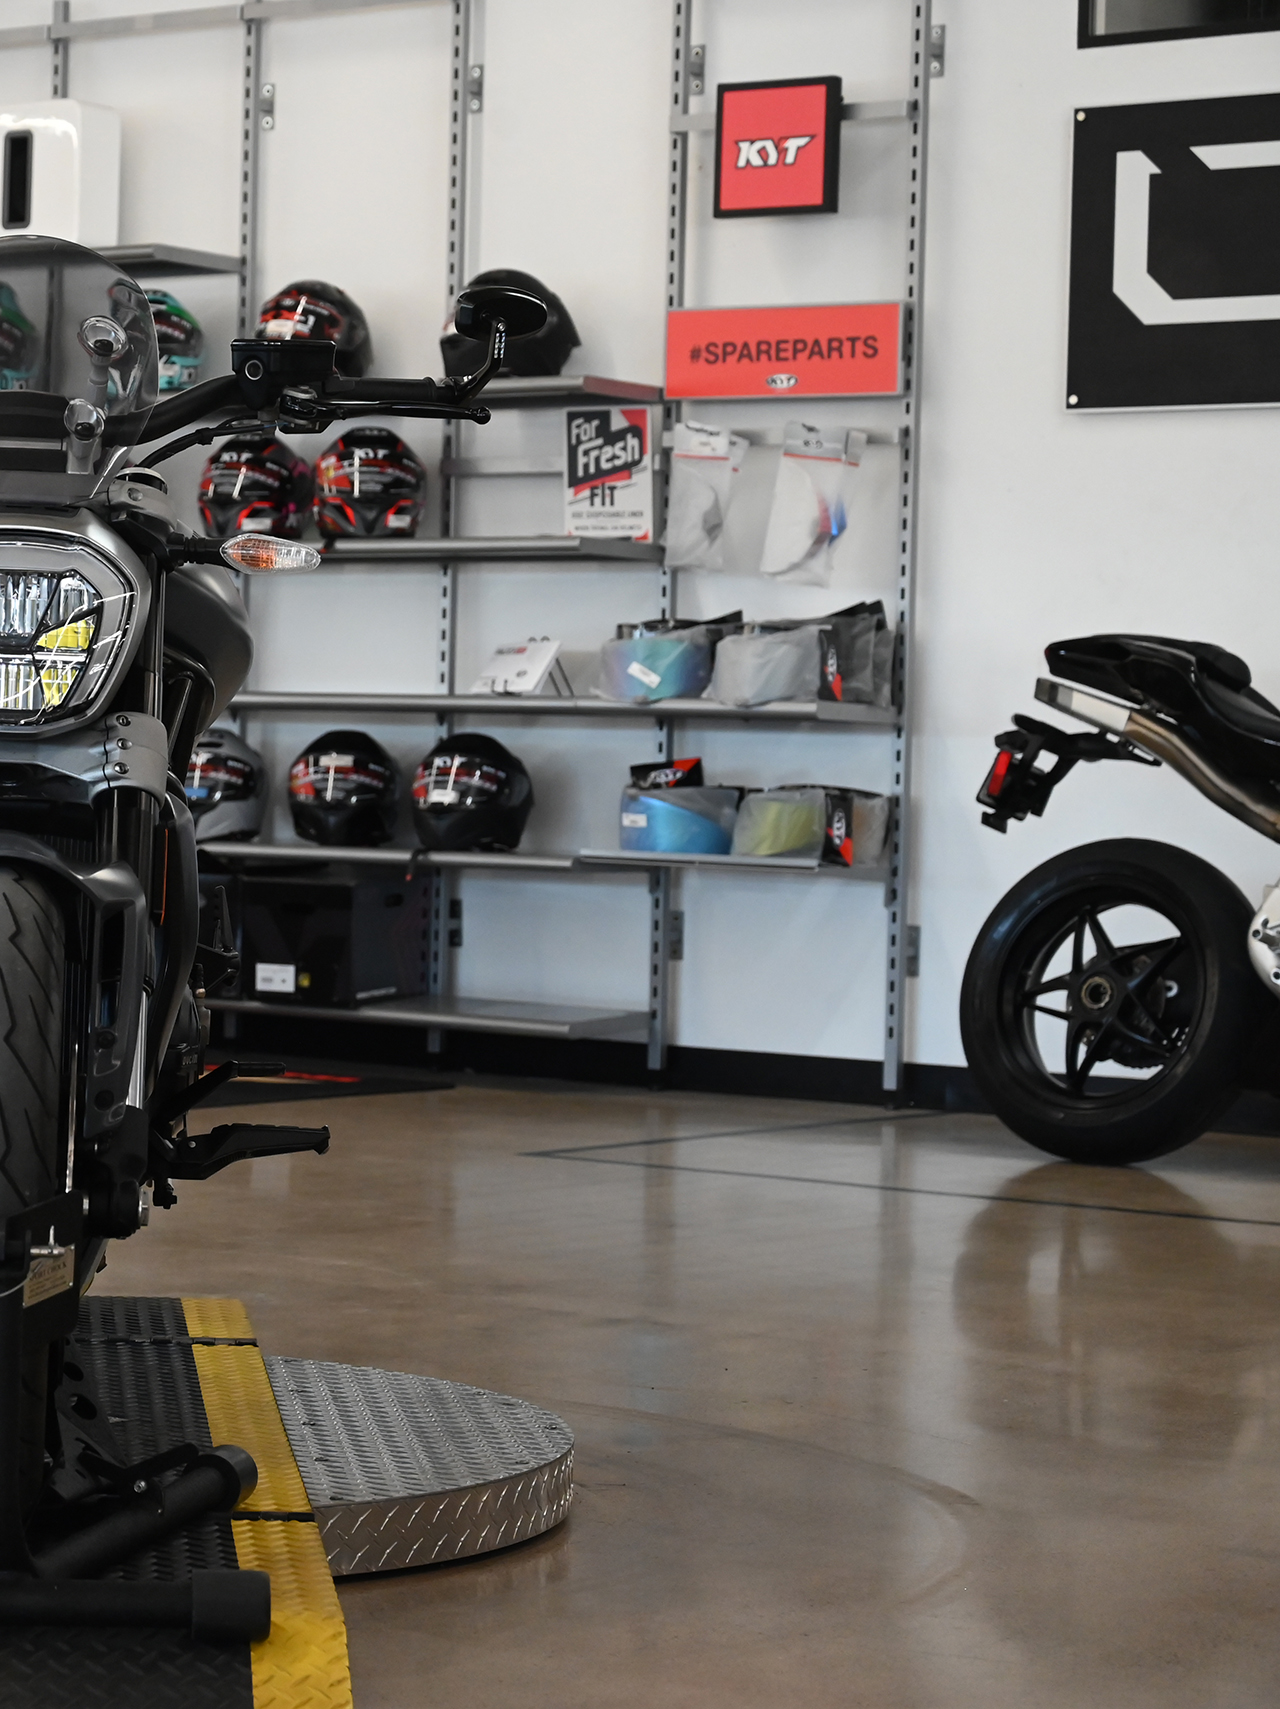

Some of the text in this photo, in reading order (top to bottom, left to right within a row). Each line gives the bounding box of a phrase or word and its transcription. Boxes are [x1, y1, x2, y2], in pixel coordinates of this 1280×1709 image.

[735, 134, 816, 169] KYT
[689, 335, 879, 365] #SPAREPARTS
[571, 417, 600, 446] For
[577, 432, 640, 478] Fresh
[589, 482, 618, 507] FIT
